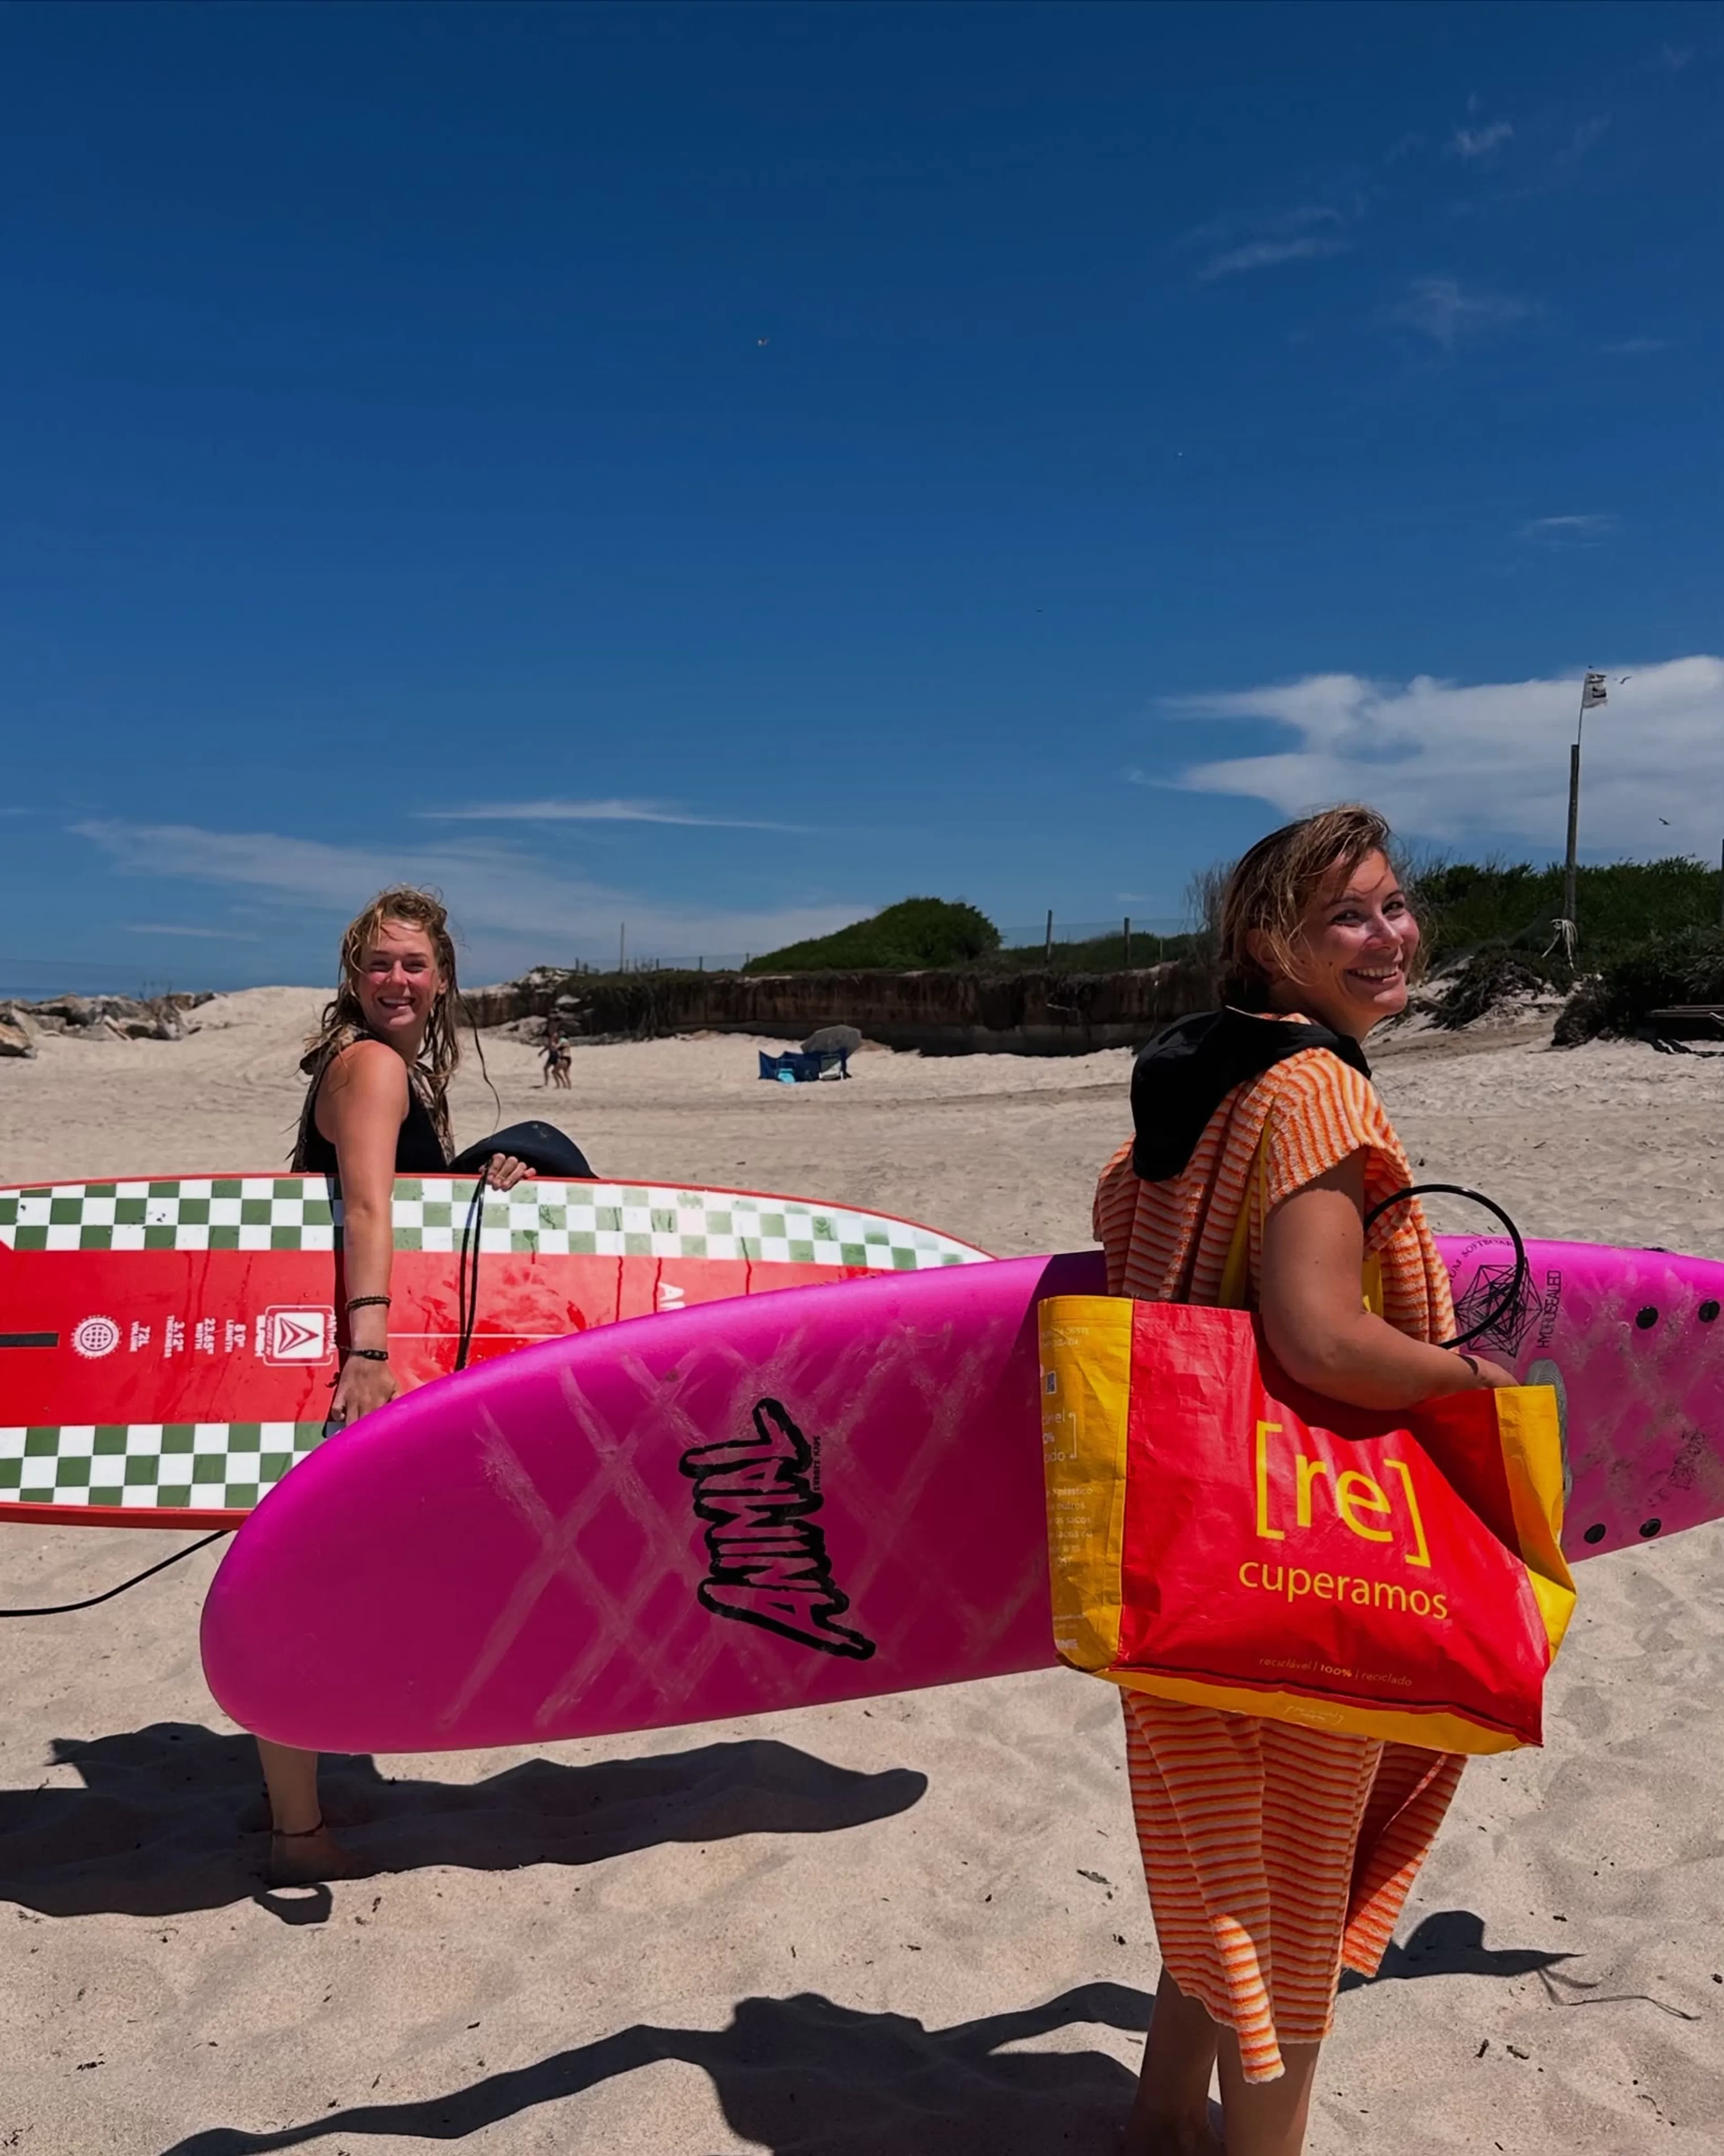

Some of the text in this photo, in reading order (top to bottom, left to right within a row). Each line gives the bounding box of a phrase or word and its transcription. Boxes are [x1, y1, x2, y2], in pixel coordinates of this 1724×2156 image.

[138, 1326, 150, 1347] 72L
[173, 1322, 185, 1352] 3.12"
[194, 1323, 204, 1349] WIDTH
[203, 1318, 216, 1355] 23.65"
[224, 1319, 234, 1353] LENGTH
[679, 1398, 876, 1661] ANIMAL
[1239, 1562, 1448, 1619] cuperamos
[1320, 1665, 1352, 1677] 100%
[1361, 1672, 1412, 1686] reciclado
